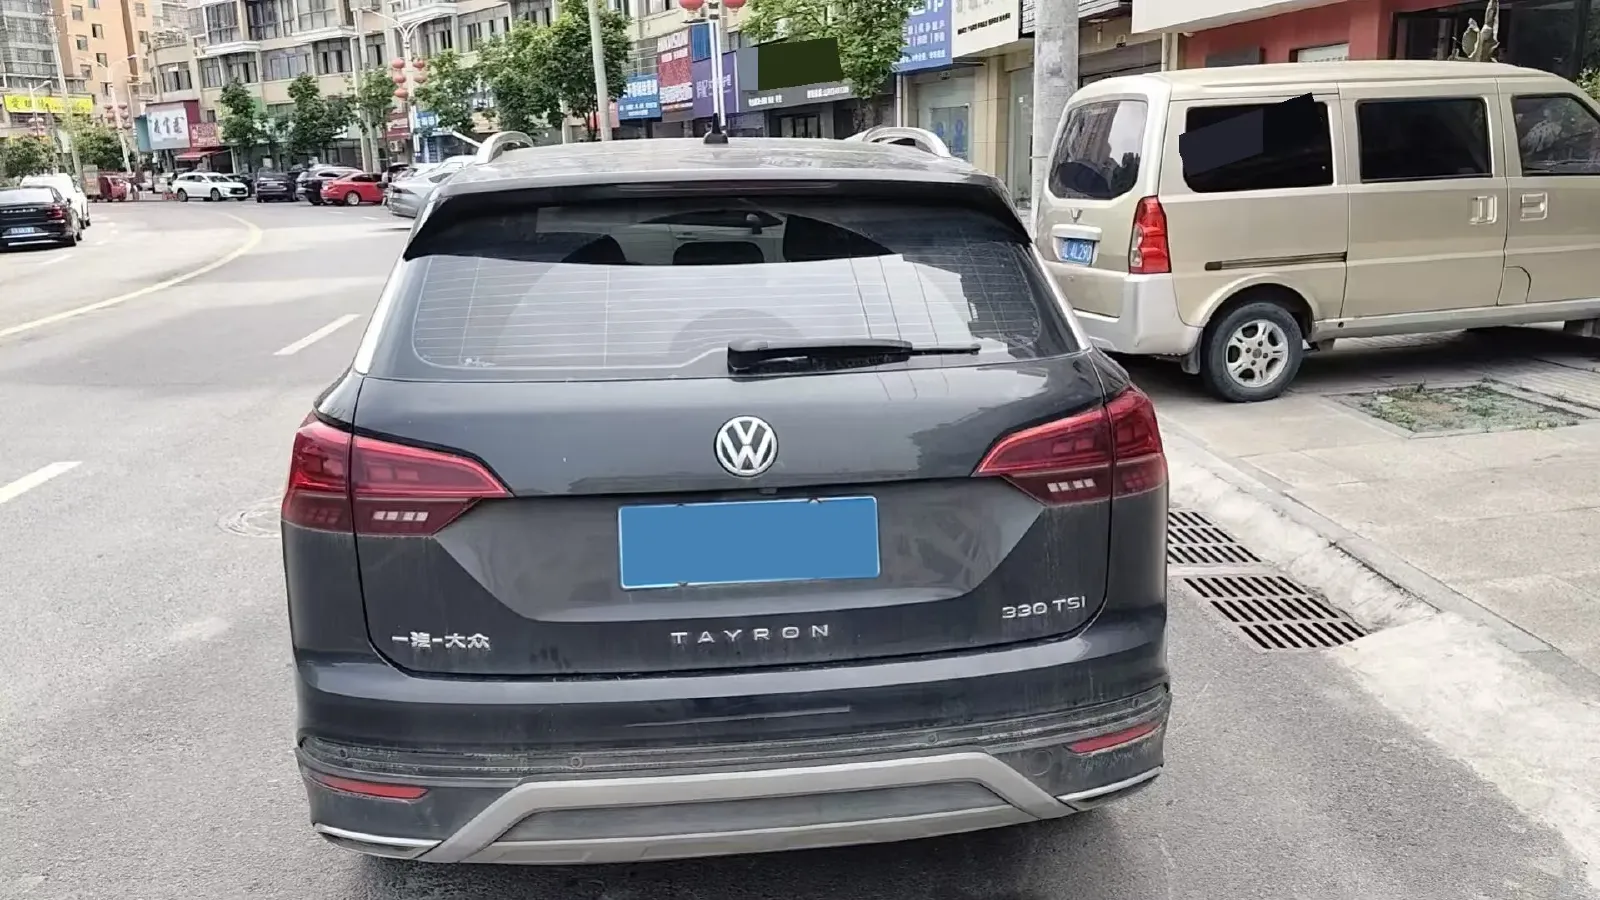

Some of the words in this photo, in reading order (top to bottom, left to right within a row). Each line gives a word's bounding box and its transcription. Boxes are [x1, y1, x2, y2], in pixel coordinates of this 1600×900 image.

[1002, 602, 1048, 619] 330
[1052, 595, 1086, 612] TSI
[670, 624, 829, 645] TAYRON
